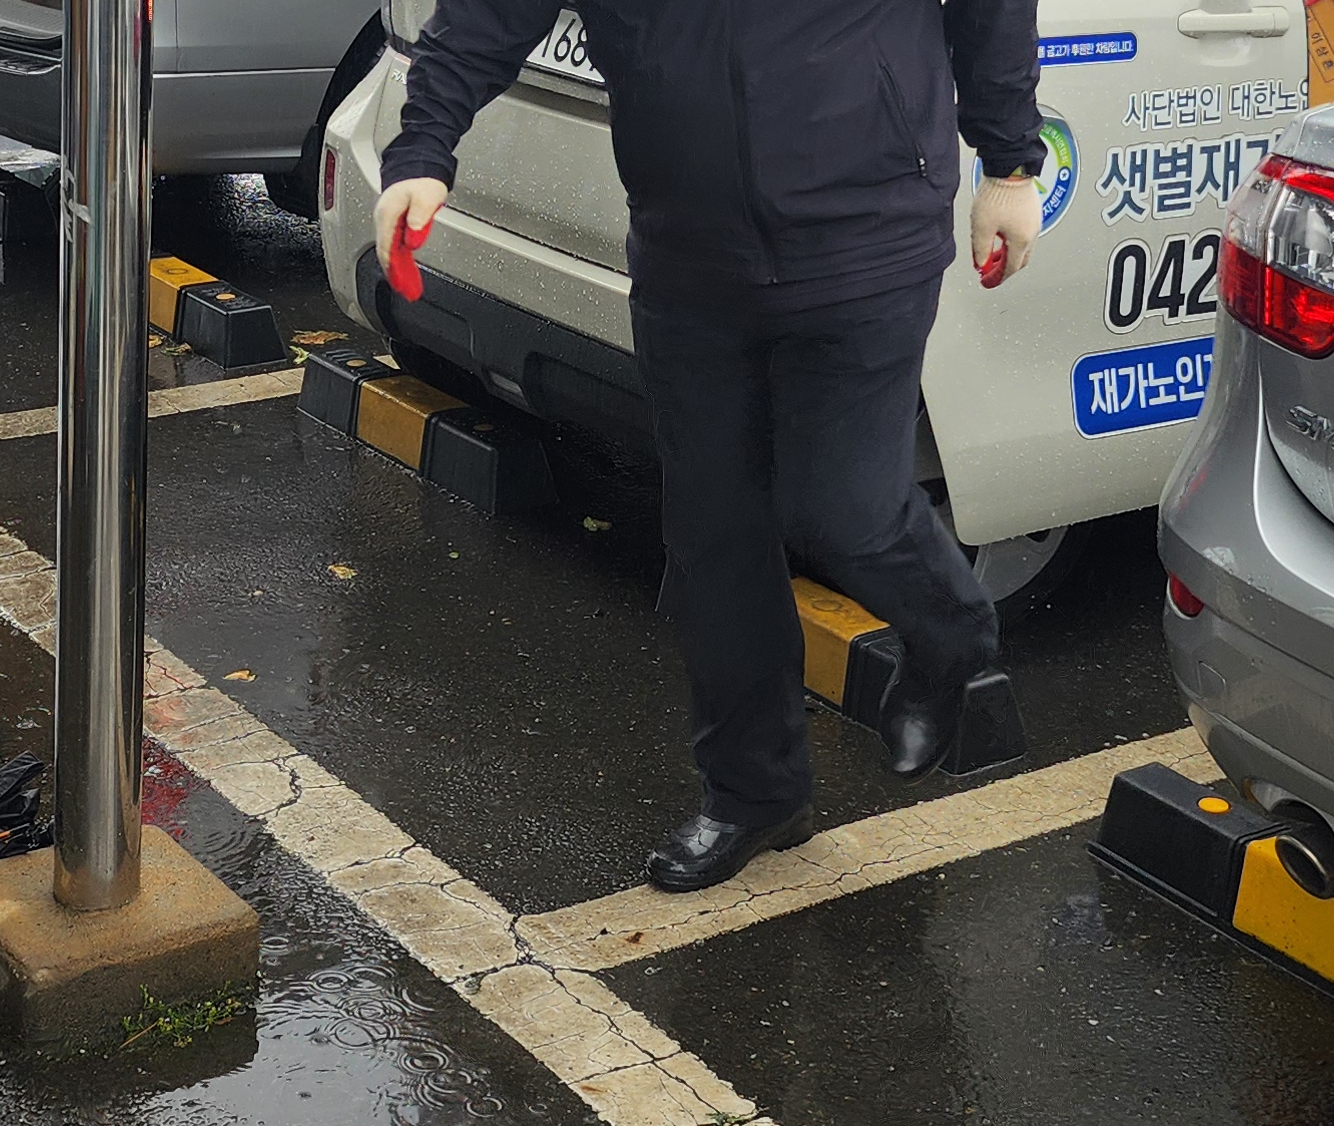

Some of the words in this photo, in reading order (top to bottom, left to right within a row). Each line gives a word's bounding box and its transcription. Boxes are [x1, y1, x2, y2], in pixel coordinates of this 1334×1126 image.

[1124, 84, 1222, 129] 사단법인
[1042, 185, 1067, 217] 지센터
[1088, 353, 1214, 415] 재가노인
